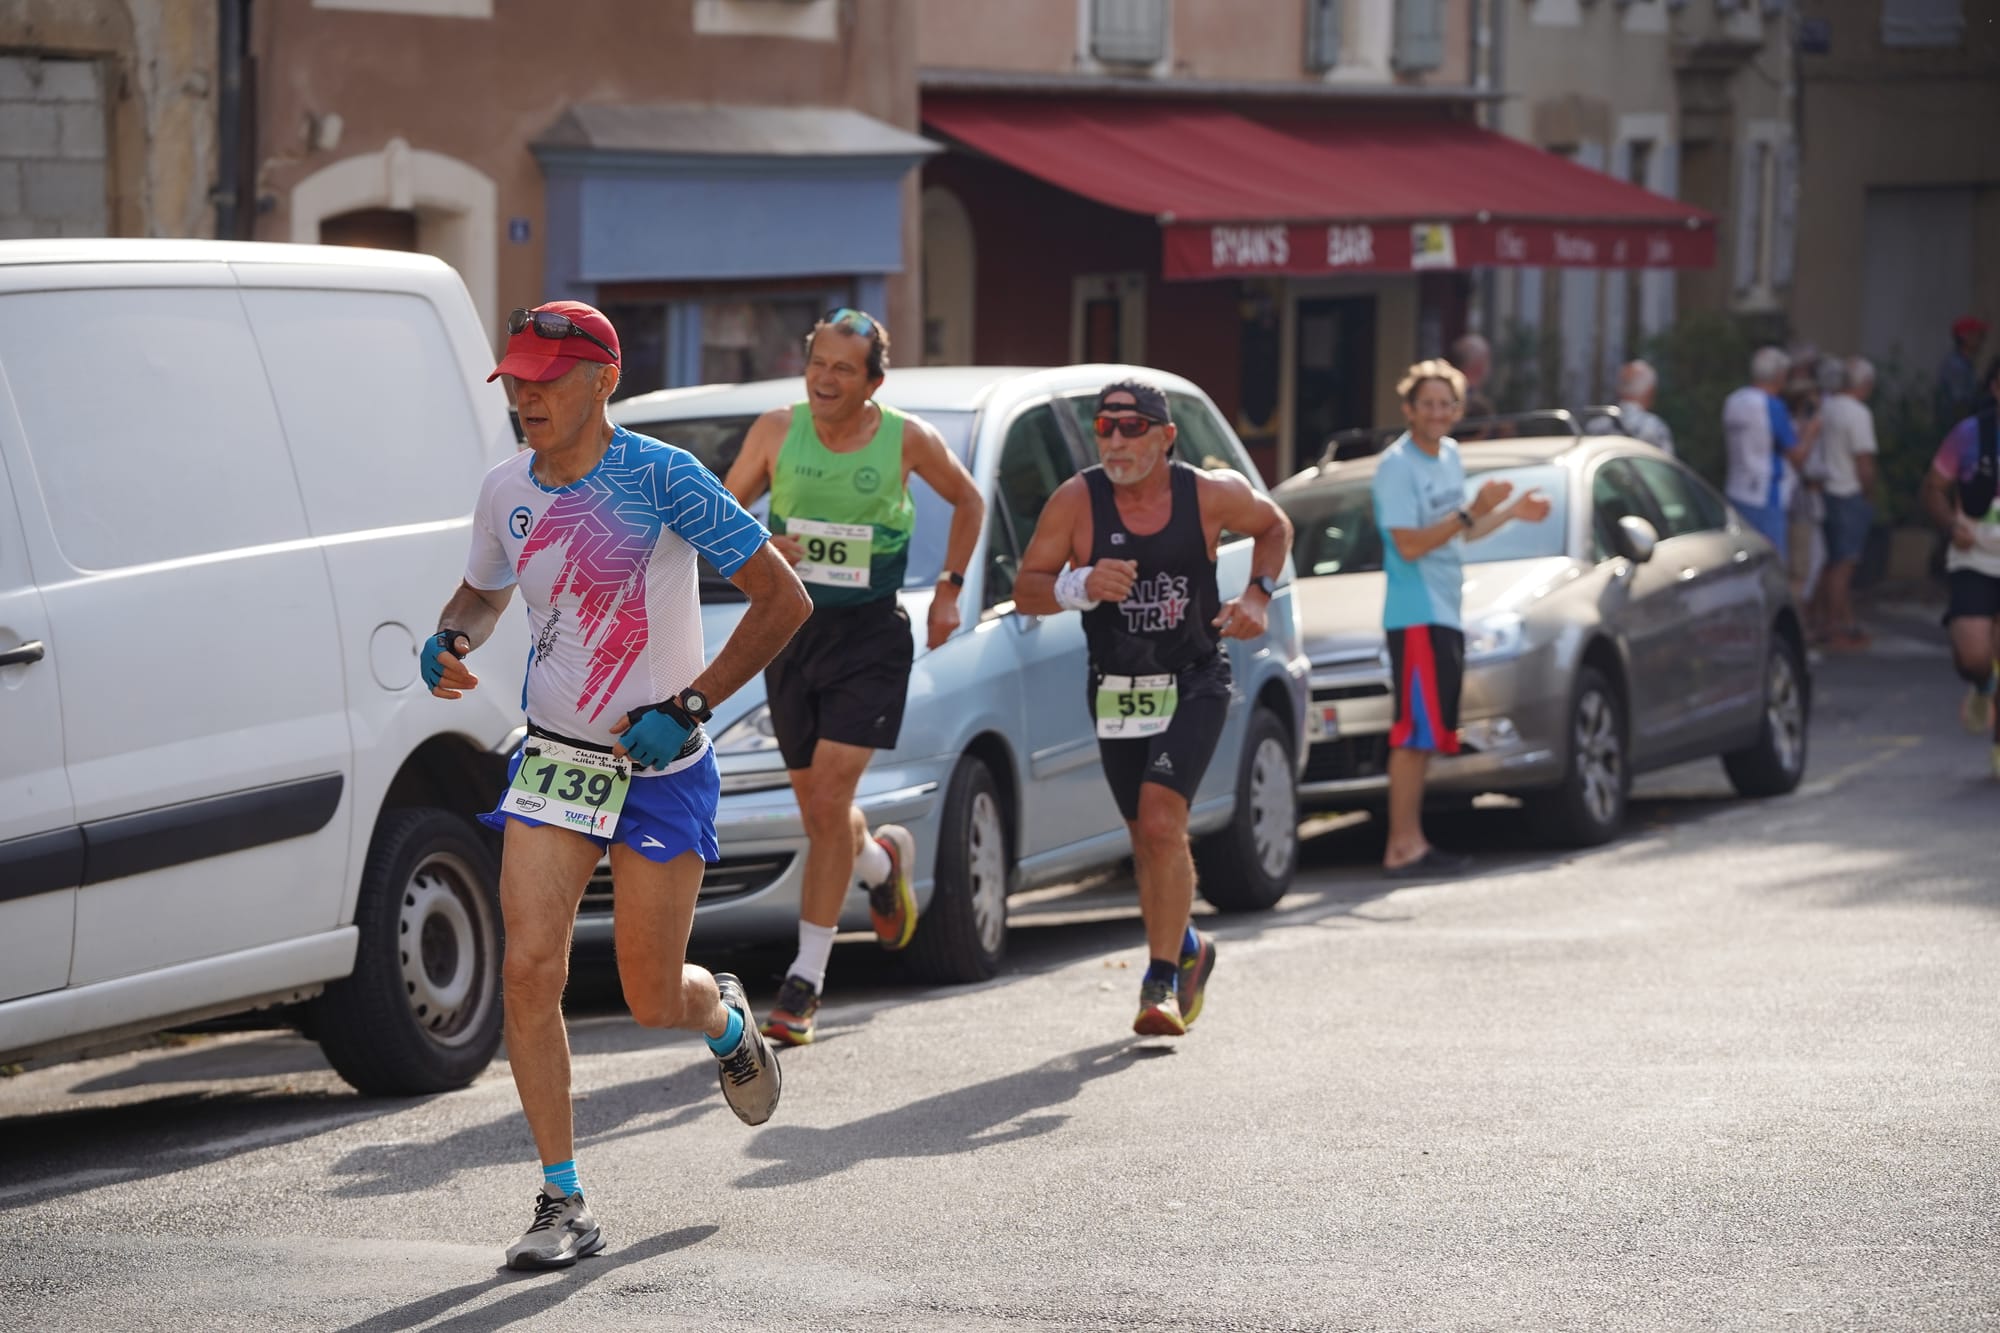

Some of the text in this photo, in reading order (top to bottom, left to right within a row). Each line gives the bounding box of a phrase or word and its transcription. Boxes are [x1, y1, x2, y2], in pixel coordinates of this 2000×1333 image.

[1211, 224, 1375, 267] RYAN'S BAR
[808, 538, 847, 564] 96
[1118, 692, 1155, 716] 55
[576, 750, 609, 762] Challenge
[536, 763, 612, 806] 139
